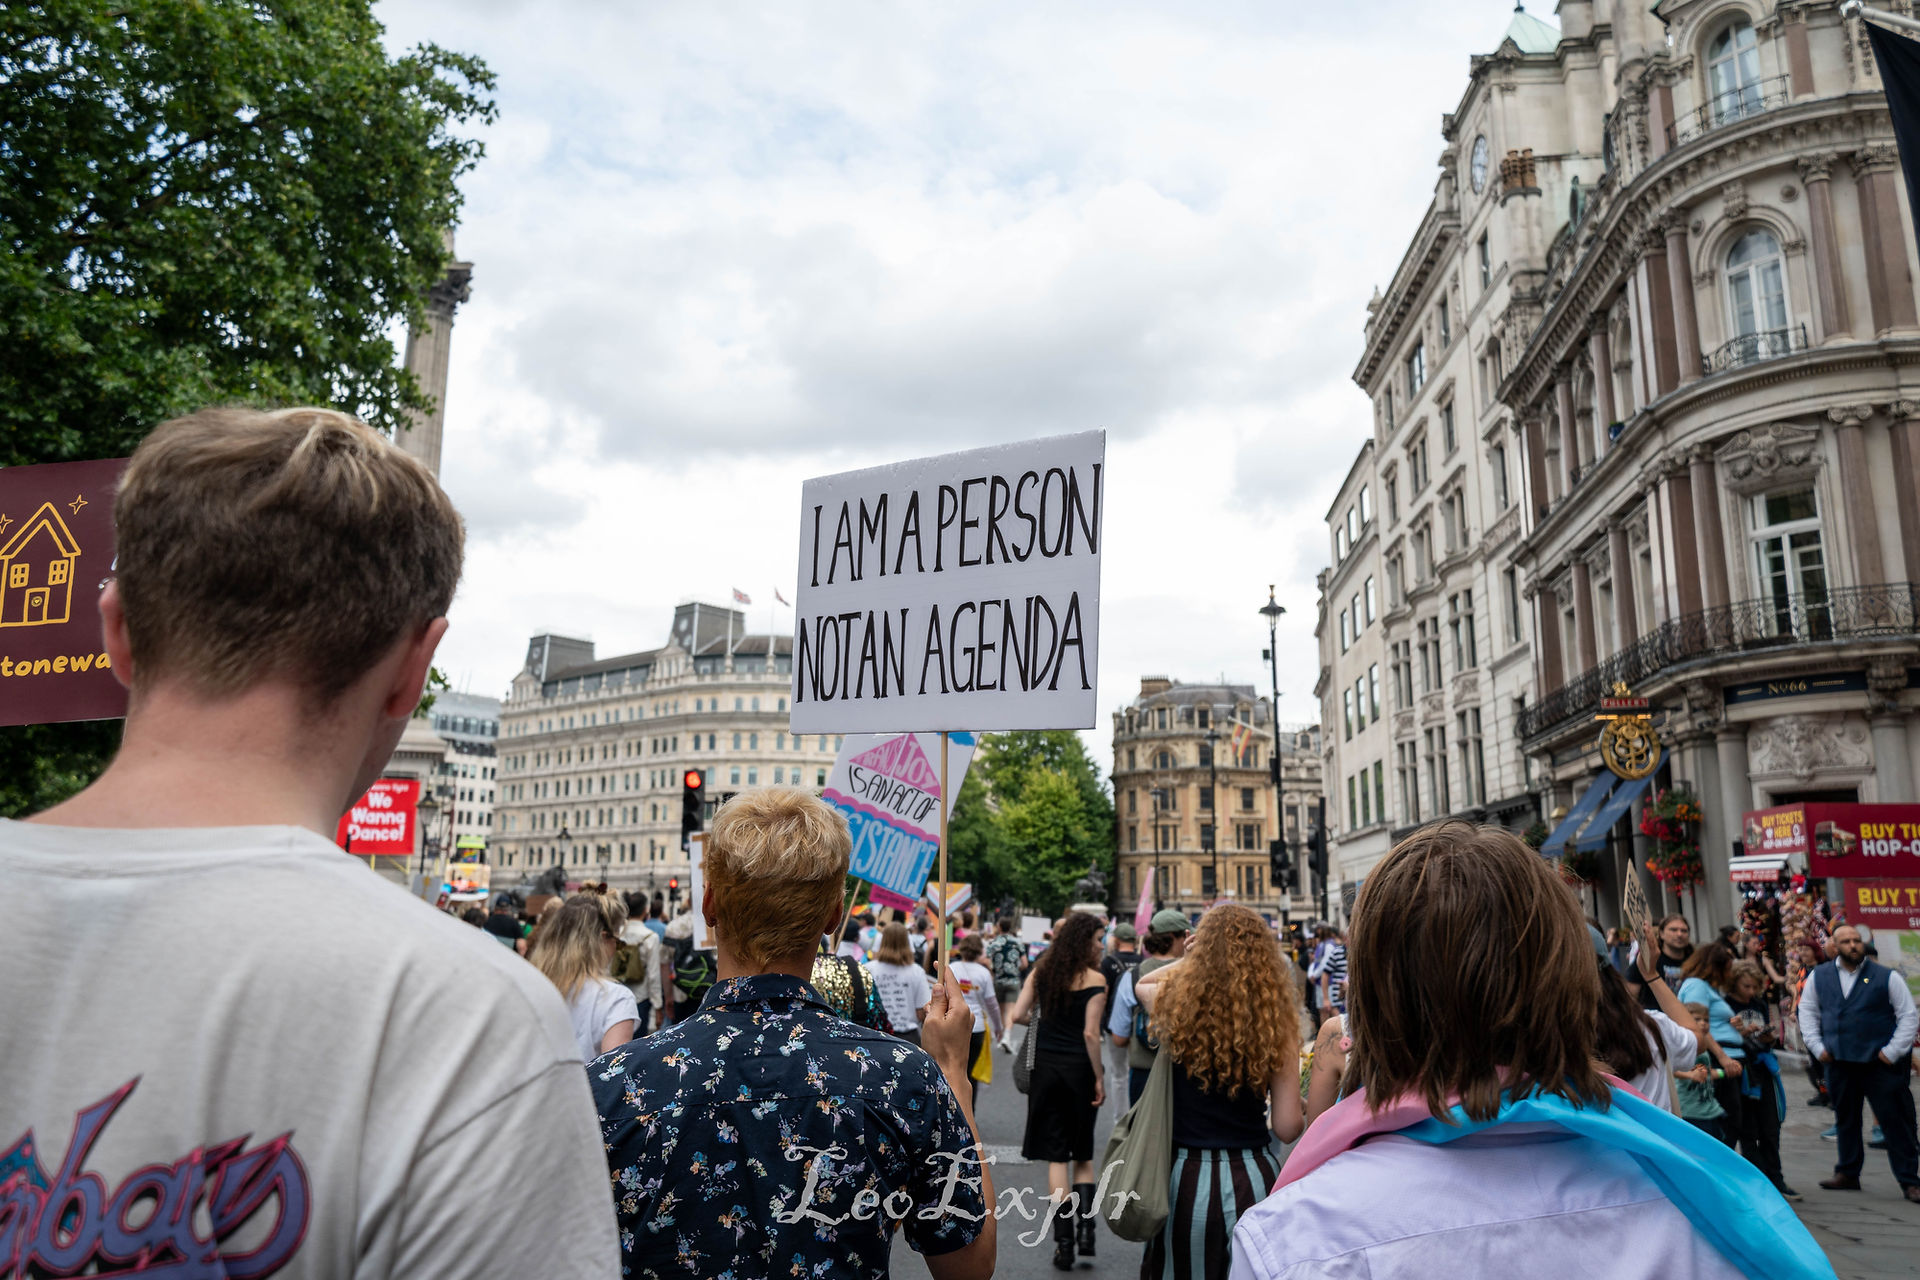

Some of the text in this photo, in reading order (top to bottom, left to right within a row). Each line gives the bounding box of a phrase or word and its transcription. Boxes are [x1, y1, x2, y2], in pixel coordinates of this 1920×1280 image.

[811, 463, 1101, 587] I AM A PERSON
[796, 591, 1092, 703] NOT AN AGENDA
[895, 741, 939, 790] JOY
[368, 792, 393, 808] We
[849, 764, 941, 824] IS AN ACT OF
[351, 807, 407, 825] Wanna
[1762, 810, 1803, 828] BUY TICKETS
[1774, 824, 1792, 838] HERE
[1860, 823, 1896, 839] BUY
[1858, 887, 1920, 907] BUY T
